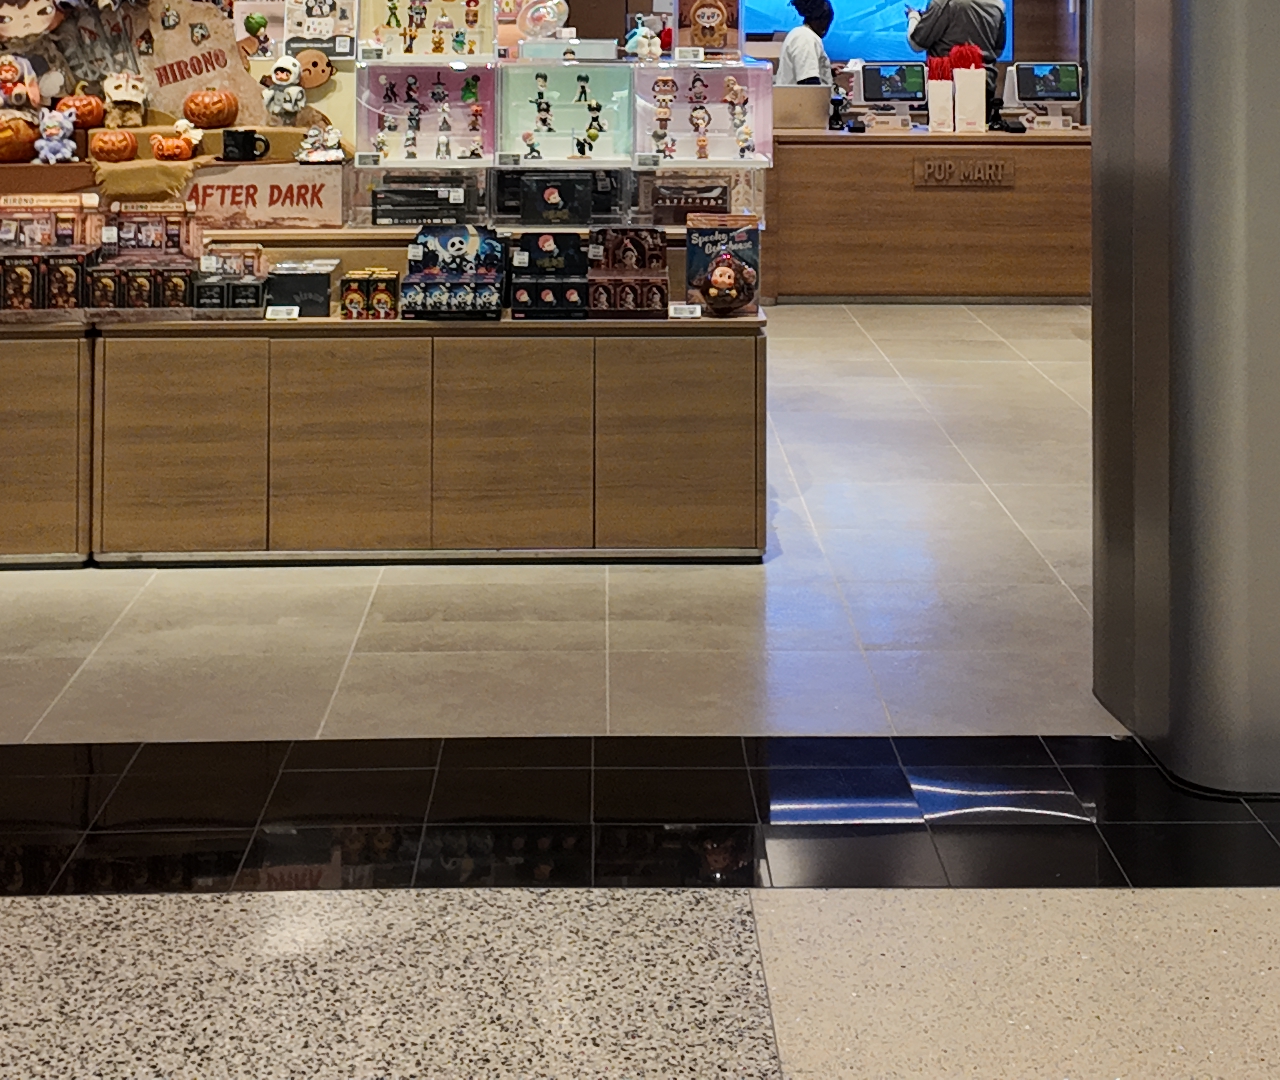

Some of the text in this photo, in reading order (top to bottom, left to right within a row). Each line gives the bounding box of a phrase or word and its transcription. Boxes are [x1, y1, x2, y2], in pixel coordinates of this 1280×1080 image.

[154, 48, 228, 88] HIRONO
[924, 160, 1006, 182] POP MART
[187, 183, 326, 209] AFTER DARK
